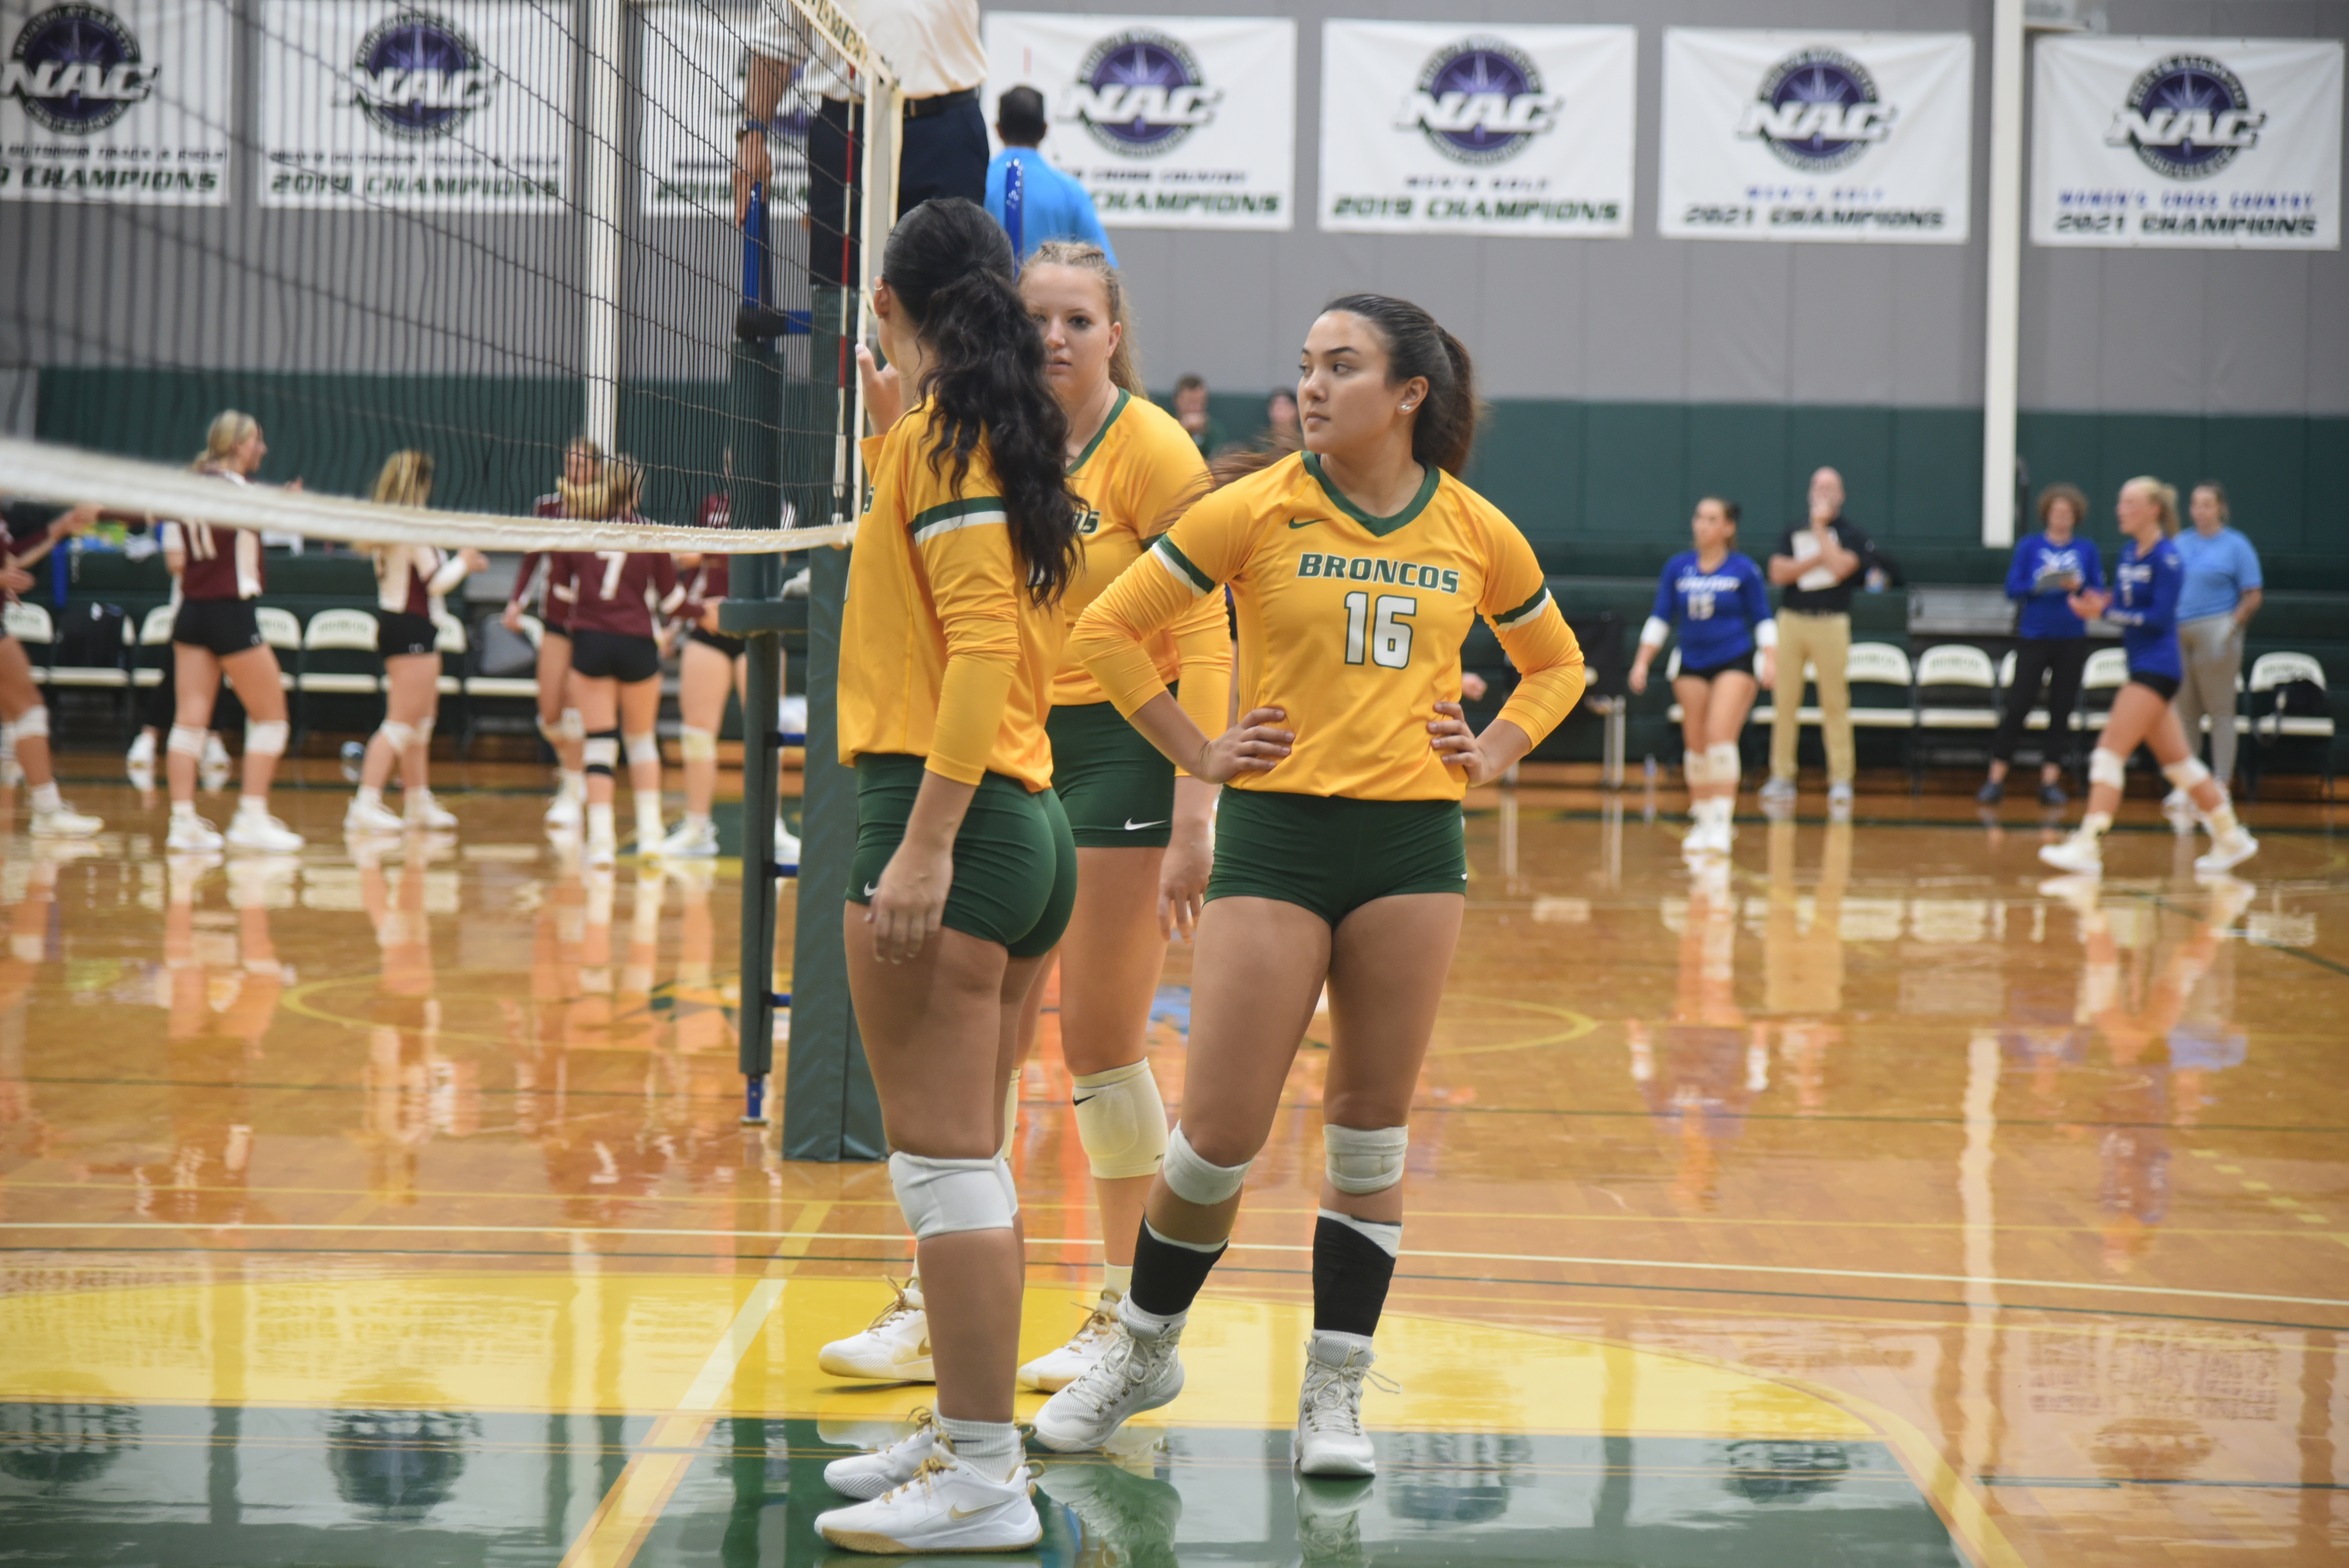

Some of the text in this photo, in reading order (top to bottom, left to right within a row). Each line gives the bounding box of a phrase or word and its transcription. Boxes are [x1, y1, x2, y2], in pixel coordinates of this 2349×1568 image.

[0, 60, 160, 100] NAC
[330, 66, 500, 108] NAC
[1055, 82, 1224, 126] NAC
[1393, 91, 1565, 133] NAC
[1735, 101, 1898, 142] NAC
[2104, 107, 2267, 149] NAC
[22, 166, 217, 192] CHAMPIONS
[271, 172, 559, 198] 2019 CHAMPIONS
[2058, 189, 2148, 208] WOMEN'S
[1333, 196, 1619, 221] 2019 CHAMPIONS
[1683, 204, 1944, 229] 2021 CHAMPIONS
[2055, 213, 2317, 239] 2021 CHAMPIONS
[594, 551, 628, 601] 7
[1296, 552, 1459, 594] BRONCOS
[1344, 590, 1417, 670] 16
